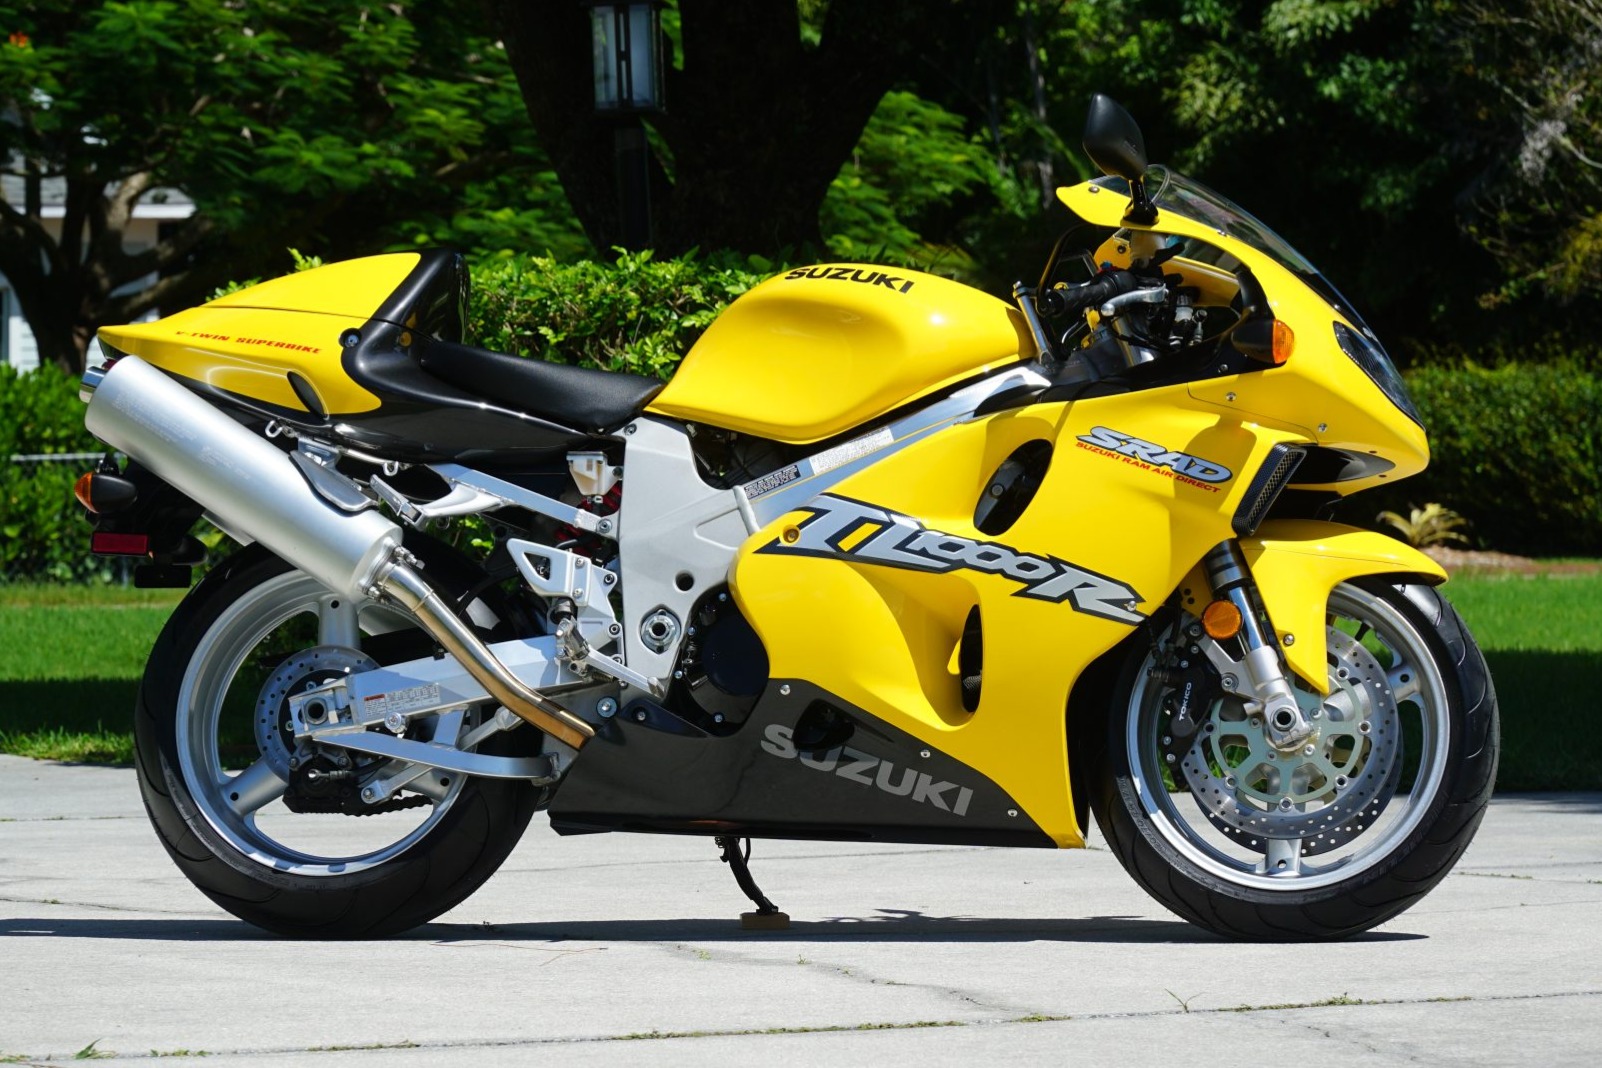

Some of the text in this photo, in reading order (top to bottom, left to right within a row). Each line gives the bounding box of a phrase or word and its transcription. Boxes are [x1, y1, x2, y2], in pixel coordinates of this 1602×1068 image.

[785, 267, 915, 294] SUZUKI
[235, 337, 323, 354] SUPERBIKE
[1075, 425, 1234, 484] SRAD
[1075, 441, 1222, 493] SUZUKI RAM AIR DIRECT
[1178, 682, 1192, 721] TOKICO
[760, 723, 974, 817] SUZUKI
